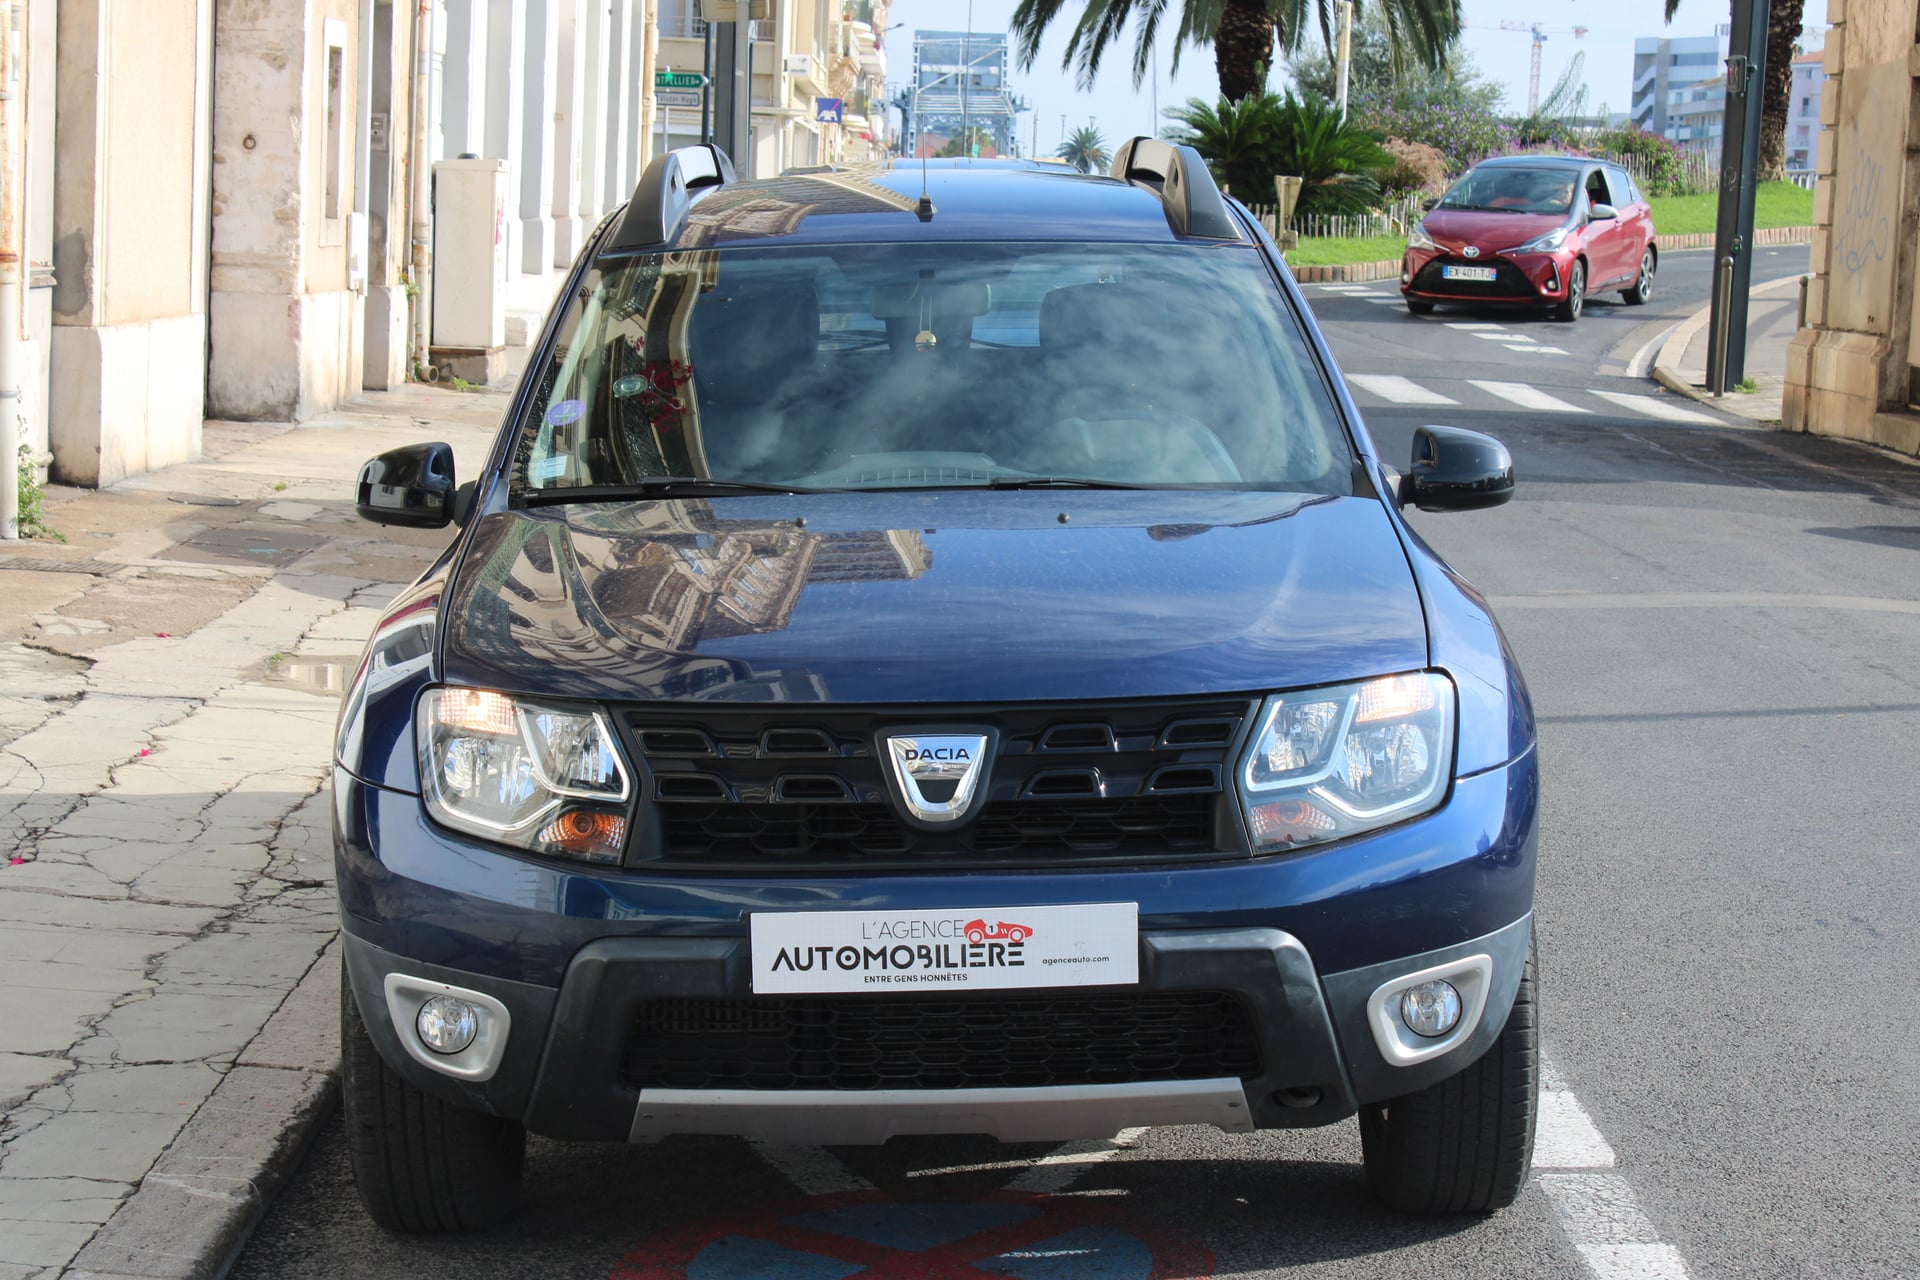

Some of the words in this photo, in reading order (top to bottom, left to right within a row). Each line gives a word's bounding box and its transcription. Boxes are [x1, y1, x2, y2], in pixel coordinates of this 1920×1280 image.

[656, 75, 695, 86] NTPELLIER
[818, 110, 839, 121] AXA
[905, 748, 970, 760] DACIA
[862, 919, 964, 939] L'AGENCE
[989, 925, 994, 933] 1
[771, 942, 1025, 972] AUTOMOBILIERE
[1042, 956, 1110, 966] agenceauto.com
[864, 975, 892, 983] ENTRE
[894, 975, 919, 983] GENS
[920, 972, 968, 982] HONNÊTES
